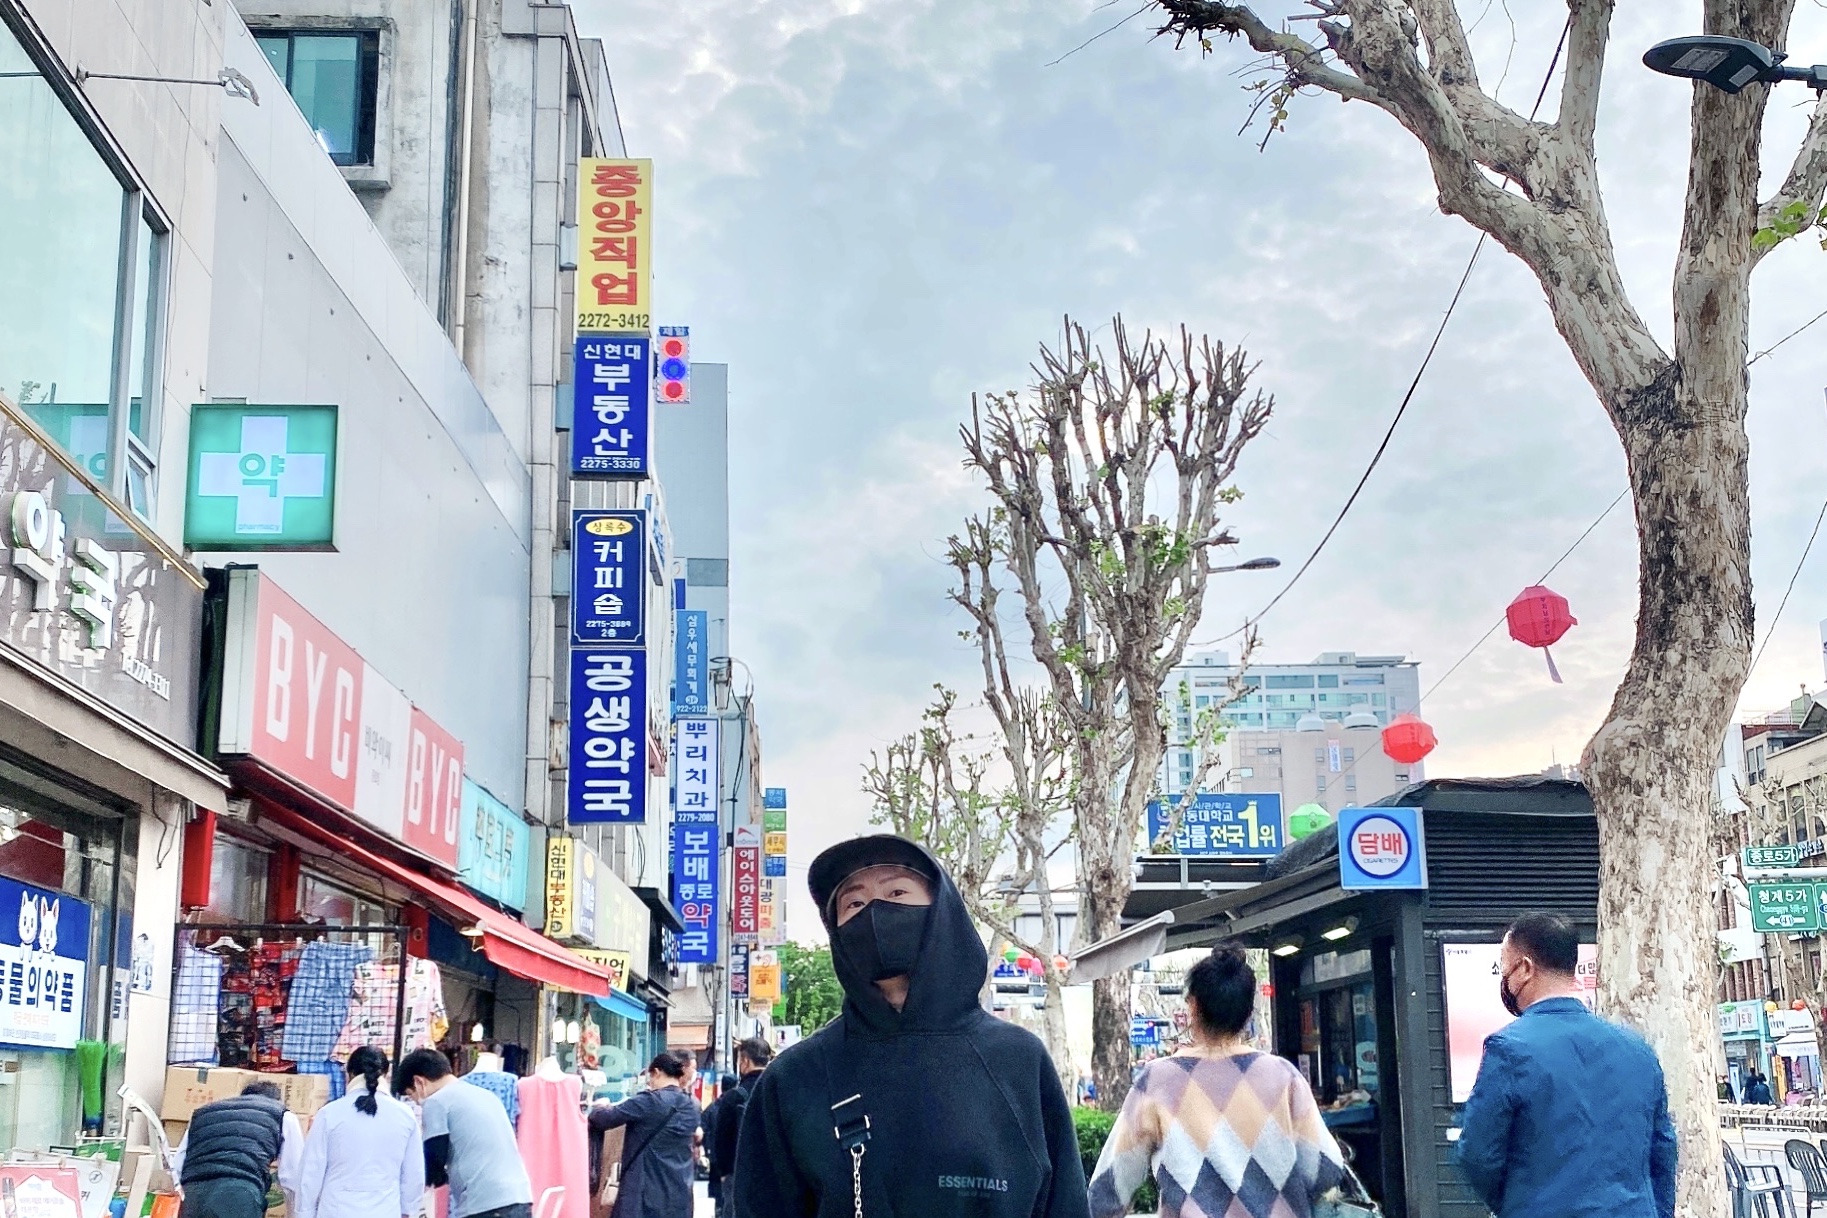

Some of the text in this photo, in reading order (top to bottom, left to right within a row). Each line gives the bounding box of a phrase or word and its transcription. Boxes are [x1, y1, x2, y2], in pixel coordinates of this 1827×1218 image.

[589, 165, 643, 306] 중앙직업
[578, 313, 650, 328] 2272-3412
[583, 344, 641, 360] 신현대
[591, 363, 634, 456] 부동산
[238, 453, 285, 498] 약
[580, 460, 641, 469] 2275-3330
[12, 489, 117, 652] 약국
[593, 540, 624, 615] 커피숍
[265, 612, 355, 781] BYC
[582, 655, 636, 817] 공생약국
[407, 726, 461, 846] BYC
[1182, 809, 1234, 823] 동대학교
[1209, 824, 1246, 849] 전국
[683, 831, 710, 882] 보배
[1358, 832, 1403, 855] 담배
[1750, 849, 1796, 864] 종로5가
[679, 883, 713, 900] 종로
[739, 849, 756, 932] 에이스아웃도어
[681, 902, 713, 957] 약국
[938, 1175, 1009, 1192] ESSENTIALS
